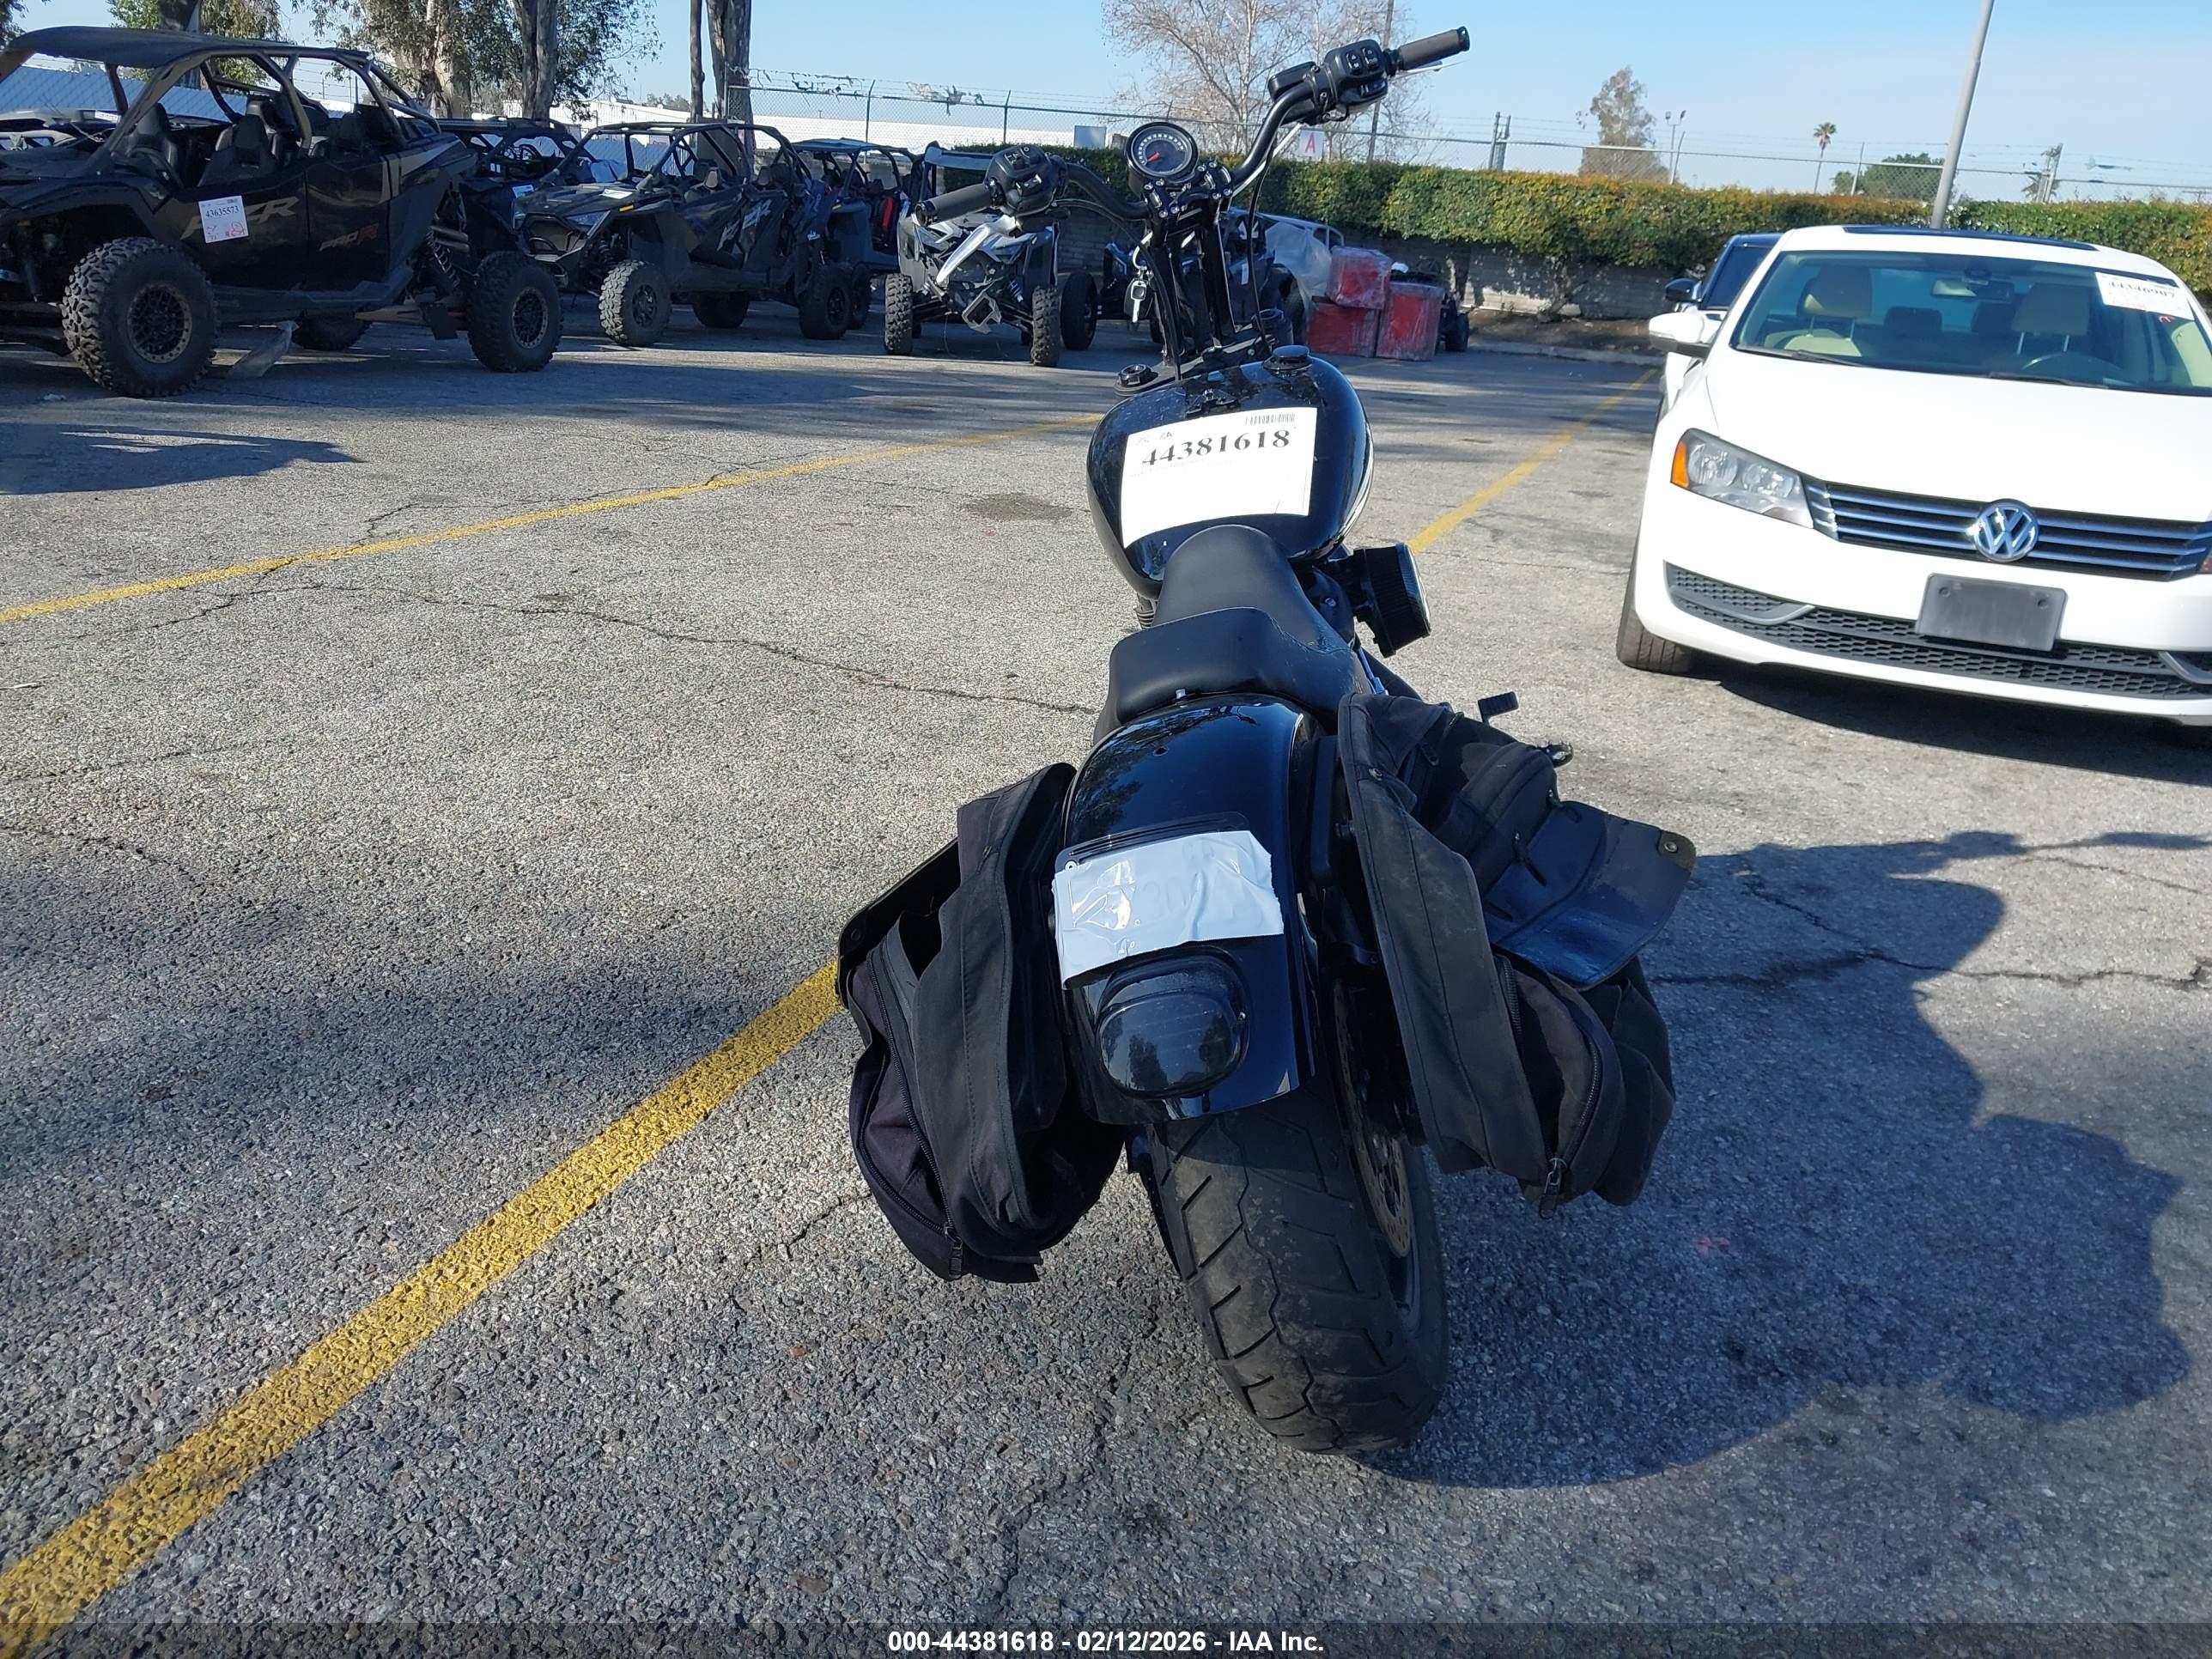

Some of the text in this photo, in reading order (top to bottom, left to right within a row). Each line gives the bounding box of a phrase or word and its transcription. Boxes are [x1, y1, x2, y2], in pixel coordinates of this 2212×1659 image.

[1305, 132, 1316, 153] A
[205, 205, 240, 217] 43635573
[1142, 429, 1291, 465] 44381618
